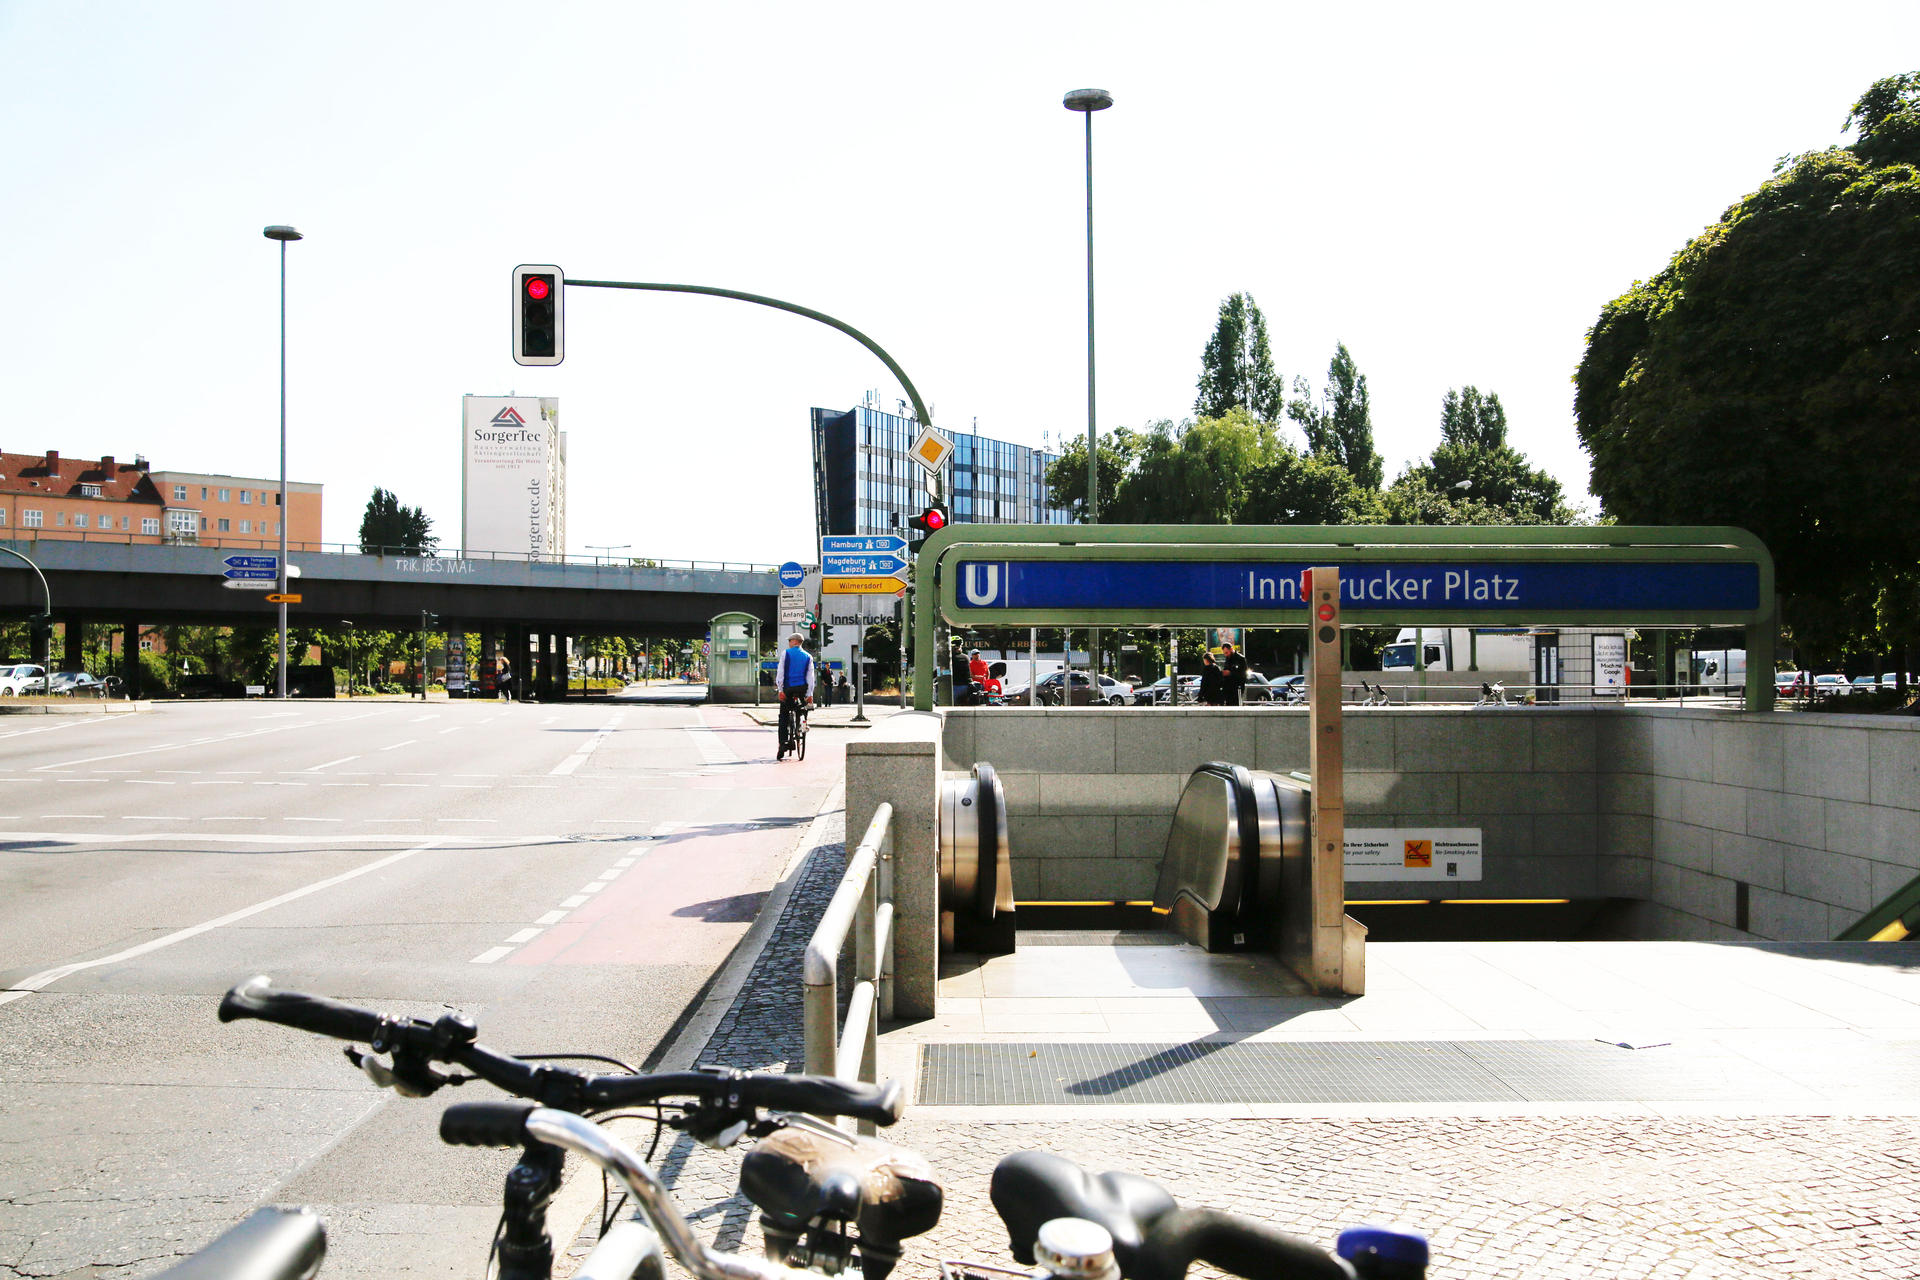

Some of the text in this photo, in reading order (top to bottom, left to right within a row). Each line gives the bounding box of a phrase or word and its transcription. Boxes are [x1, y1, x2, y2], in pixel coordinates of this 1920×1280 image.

[474, 429, 541, 444] SorgerTec
[527, 478, 543, 564] sorgertec.de
[831, 541, 863, 550] Hamburg
[827, 558, 866, 566] Magdeburg
[841, 566, 866, 574] Leipzig
[839, 582, 882, 590] Wilmersdorf
[965, 564, 1520, 606] U Innrucker Platz
[782, 611, 805, 619] Anfang
